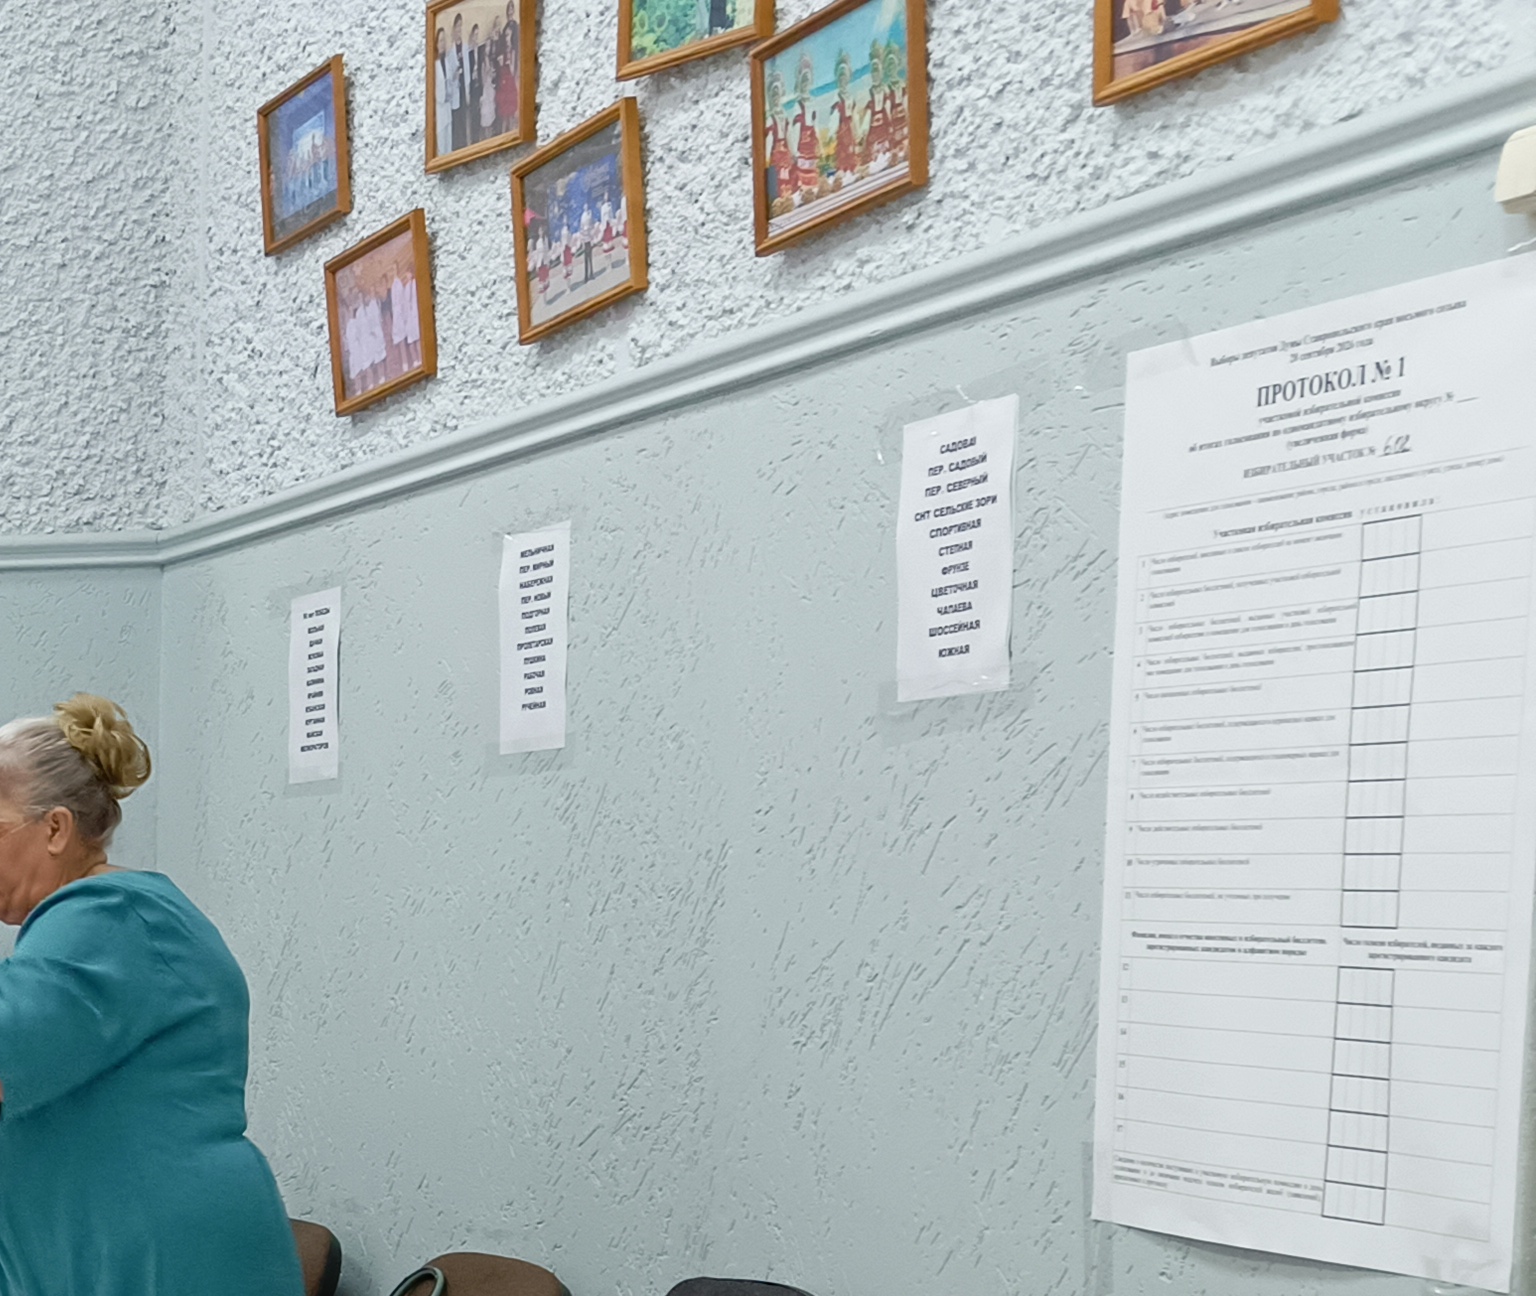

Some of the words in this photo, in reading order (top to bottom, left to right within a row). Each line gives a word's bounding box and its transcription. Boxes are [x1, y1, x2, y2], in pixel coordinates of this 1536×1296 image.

[1257, 365, 1366, 407] ПРОТОКОЛ
[1371, 360, 1391, 383] №
[1399, 357, 1404, 377] 1
[976, 495, 997, 507] ЗОРИ
[930, 519, 981, 538] СПОРТИВНАЯ
[939, 541, 972, 556] СТЕПНАЯ
[931, 580, 978, 597] ЦВЕТОЧНАЯ
[937, 602, 972, 615] ЧАПАЕВА
[929, 620, 980, 637] ШОССЕЙНАЯ
[939, 645, 969, 657] ЮЖНАЯ
